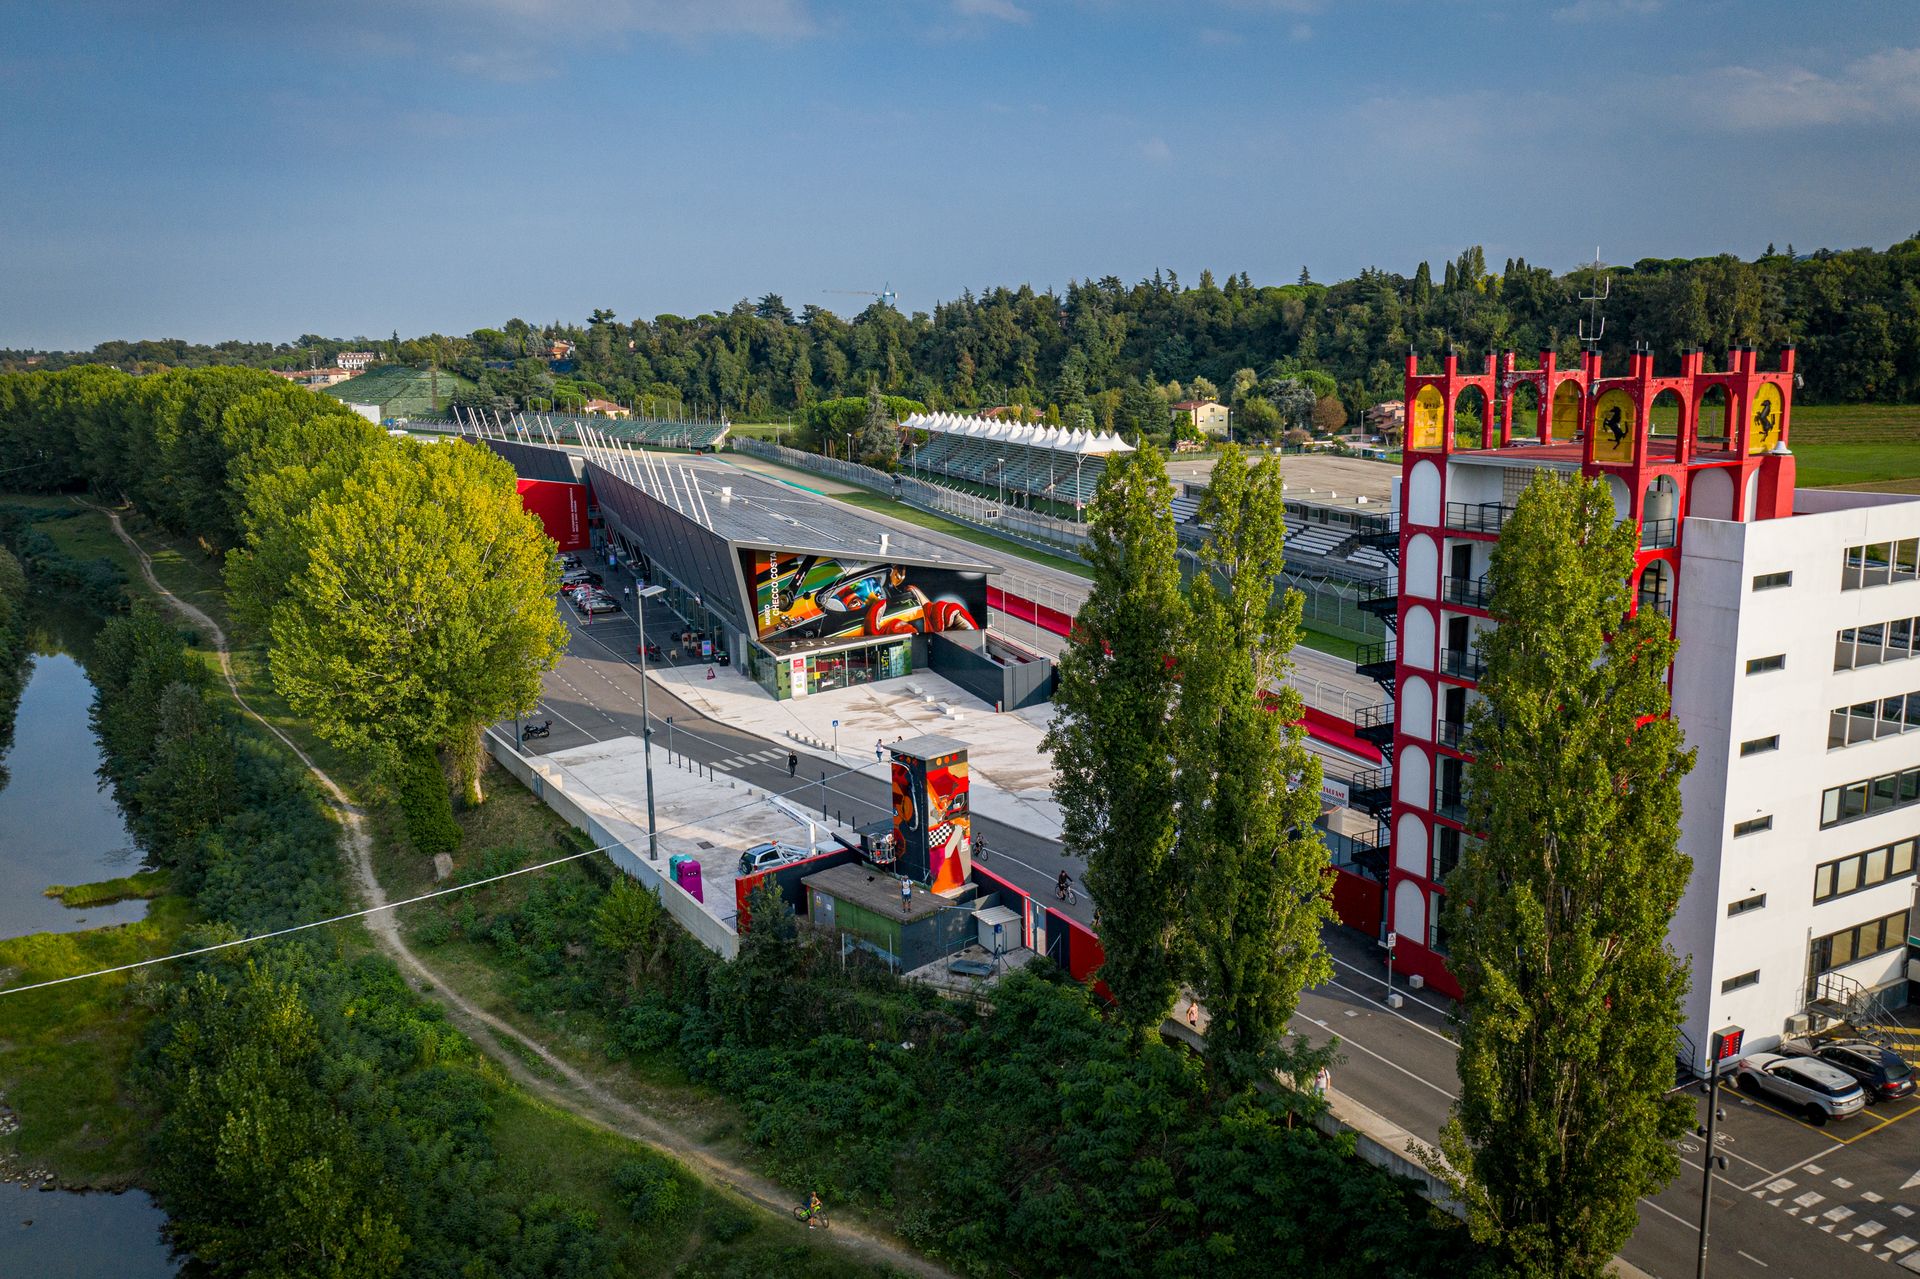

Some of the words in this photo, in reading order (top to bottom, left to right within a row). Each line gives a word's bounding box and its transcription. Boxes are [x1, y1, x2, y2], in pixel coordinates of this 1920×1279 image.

[770, 552, 778, 580] COSTA
[771, 581, 780, 617] CHECCO
[1323, 786, 1345, 799] TAURANT
